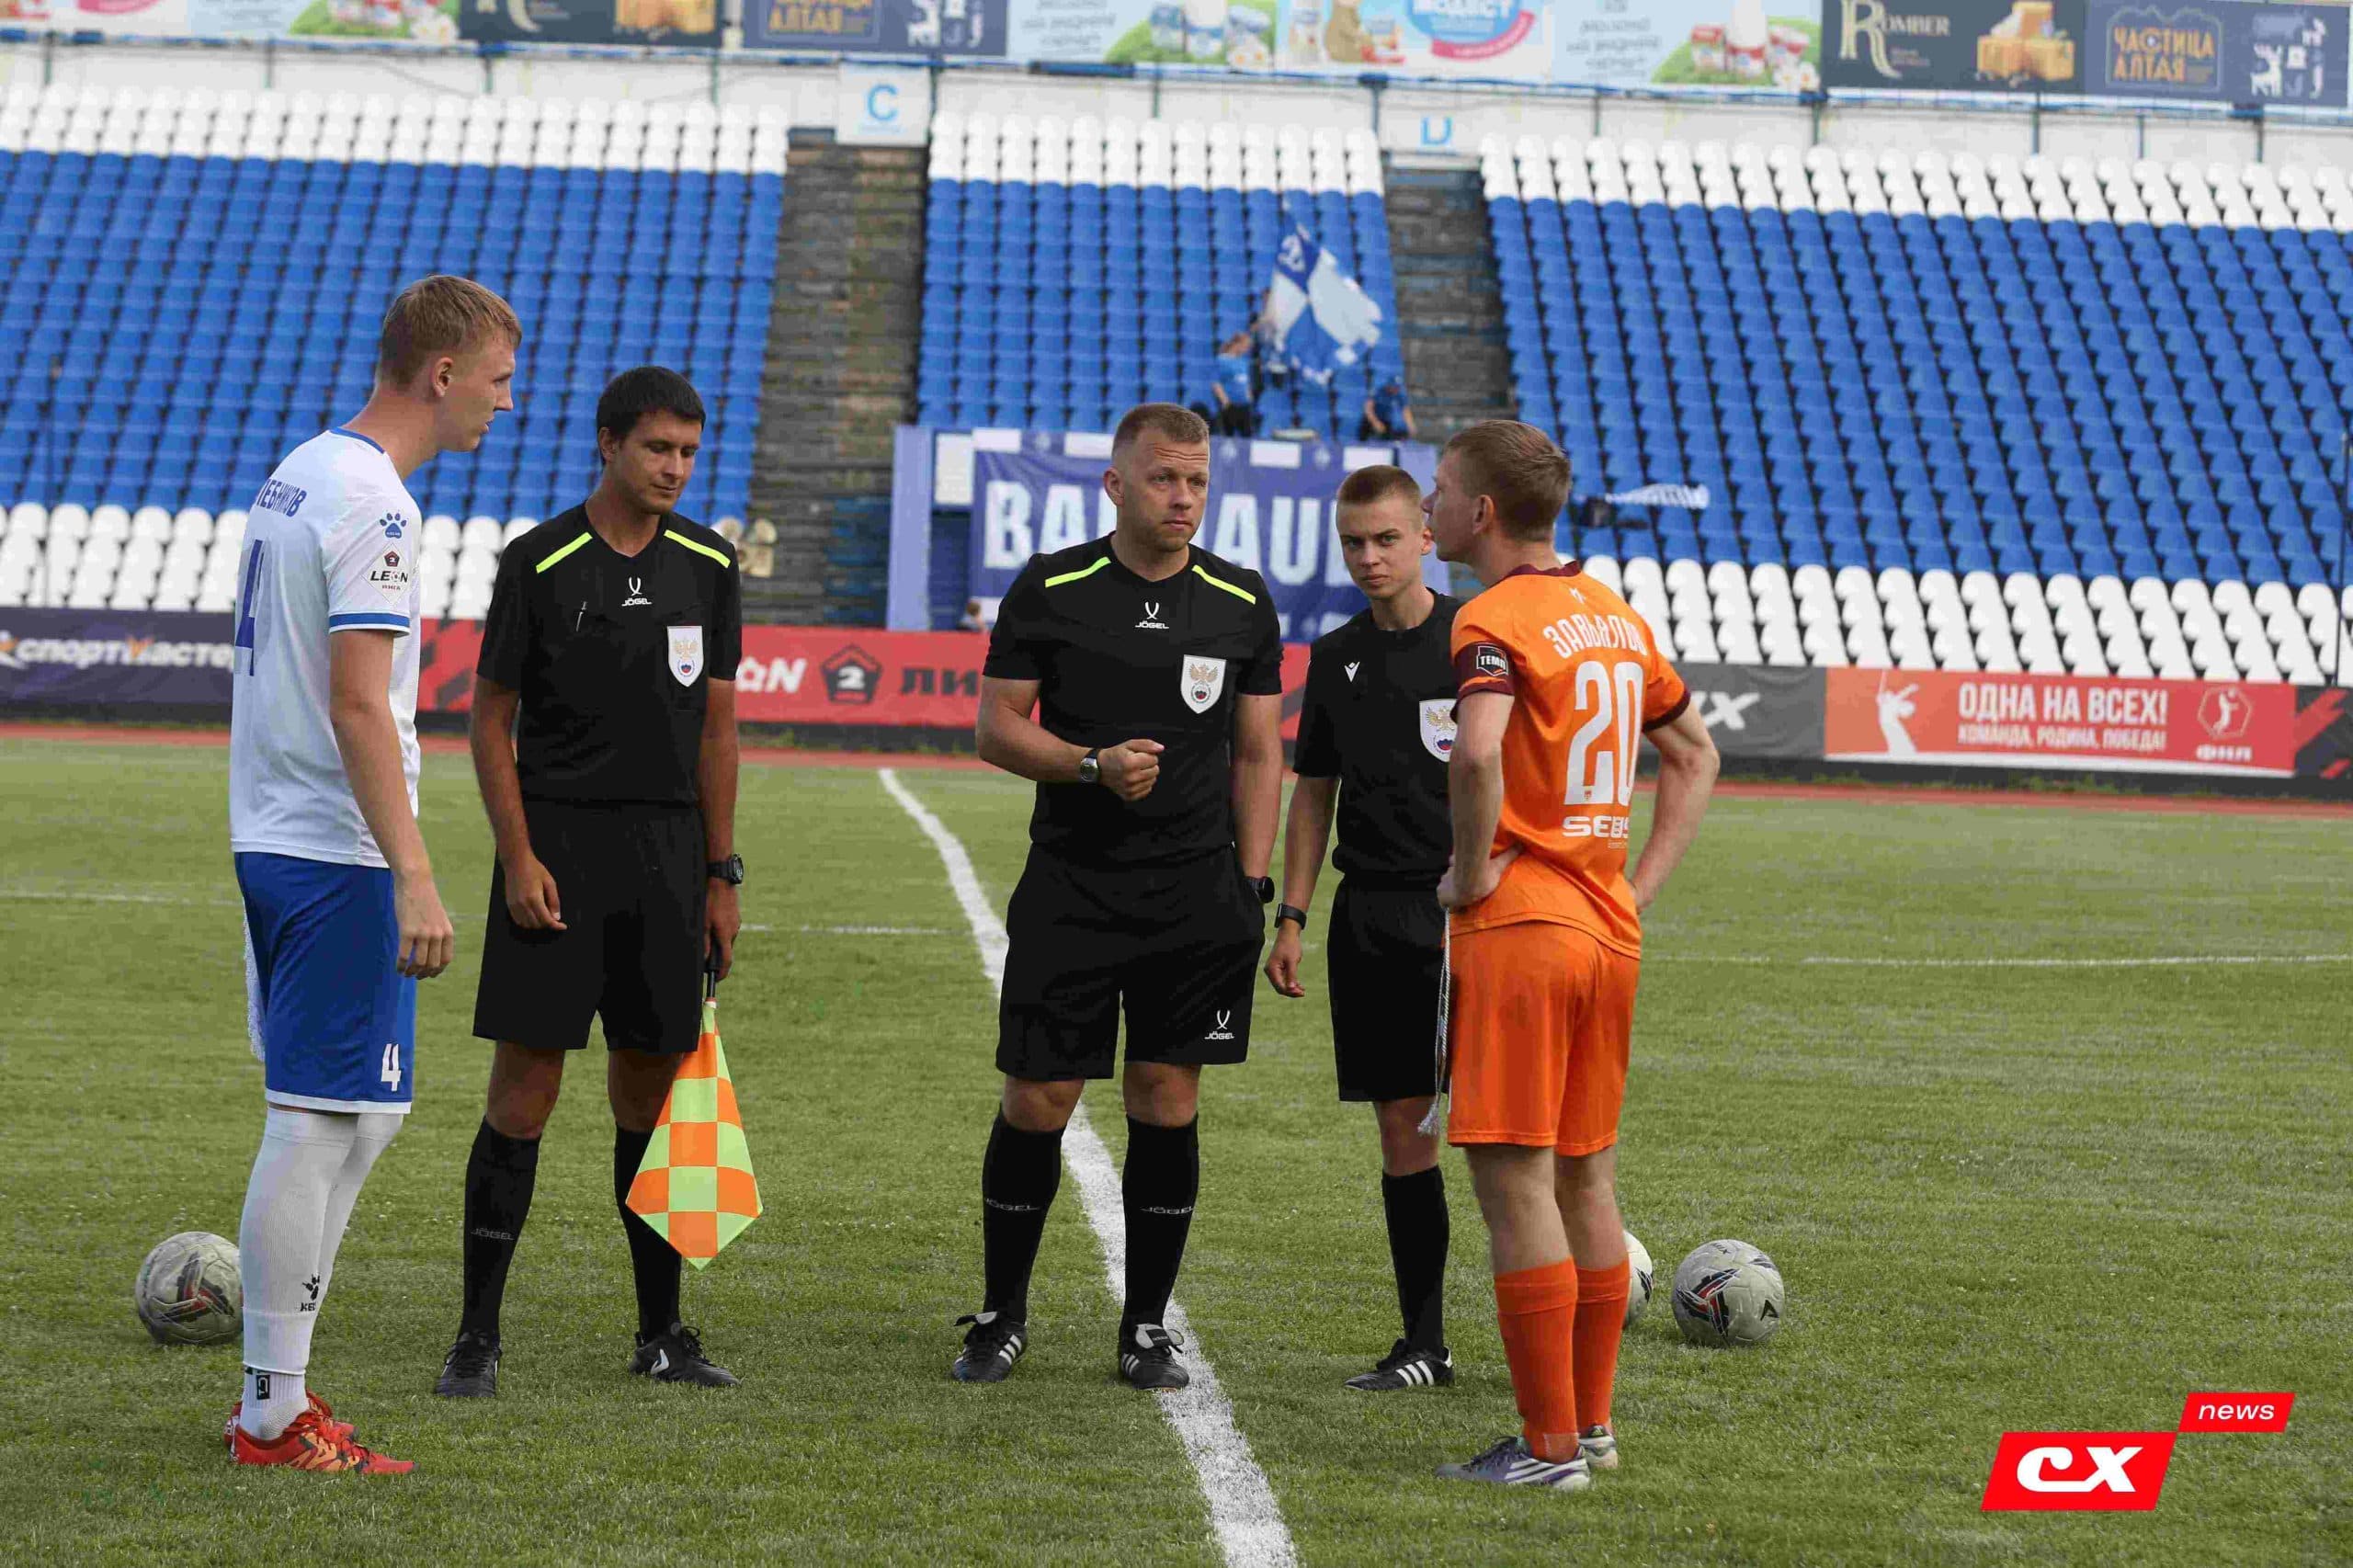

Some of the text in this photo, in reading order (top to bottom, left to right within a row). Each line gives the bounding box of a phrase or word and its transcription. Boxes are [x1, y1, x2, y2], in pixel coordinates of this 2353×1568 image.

[2114, 25, 2215, 58] ЧАСТИЦА
[2114, 53, 2185, 82] АЛТАЯ
[370, 571, 409, 583] LEON
[621, 597, 652, 607] JÖGEL
[1134, 620, 1169, 629] JÖGEL
[735, 657, 807, 693] ON
[1480, 655, 1506, 670] ТЕМП
[836, 665, 866, 689] 2
[1958, 682, 2169, 726] ОДНА НА ВСЕХ!
[1563, 660, 1644, 807] 20
[1204, 1030, 1234, 1040] JÖGEL
[381, 1043, 402, 1092] 4
